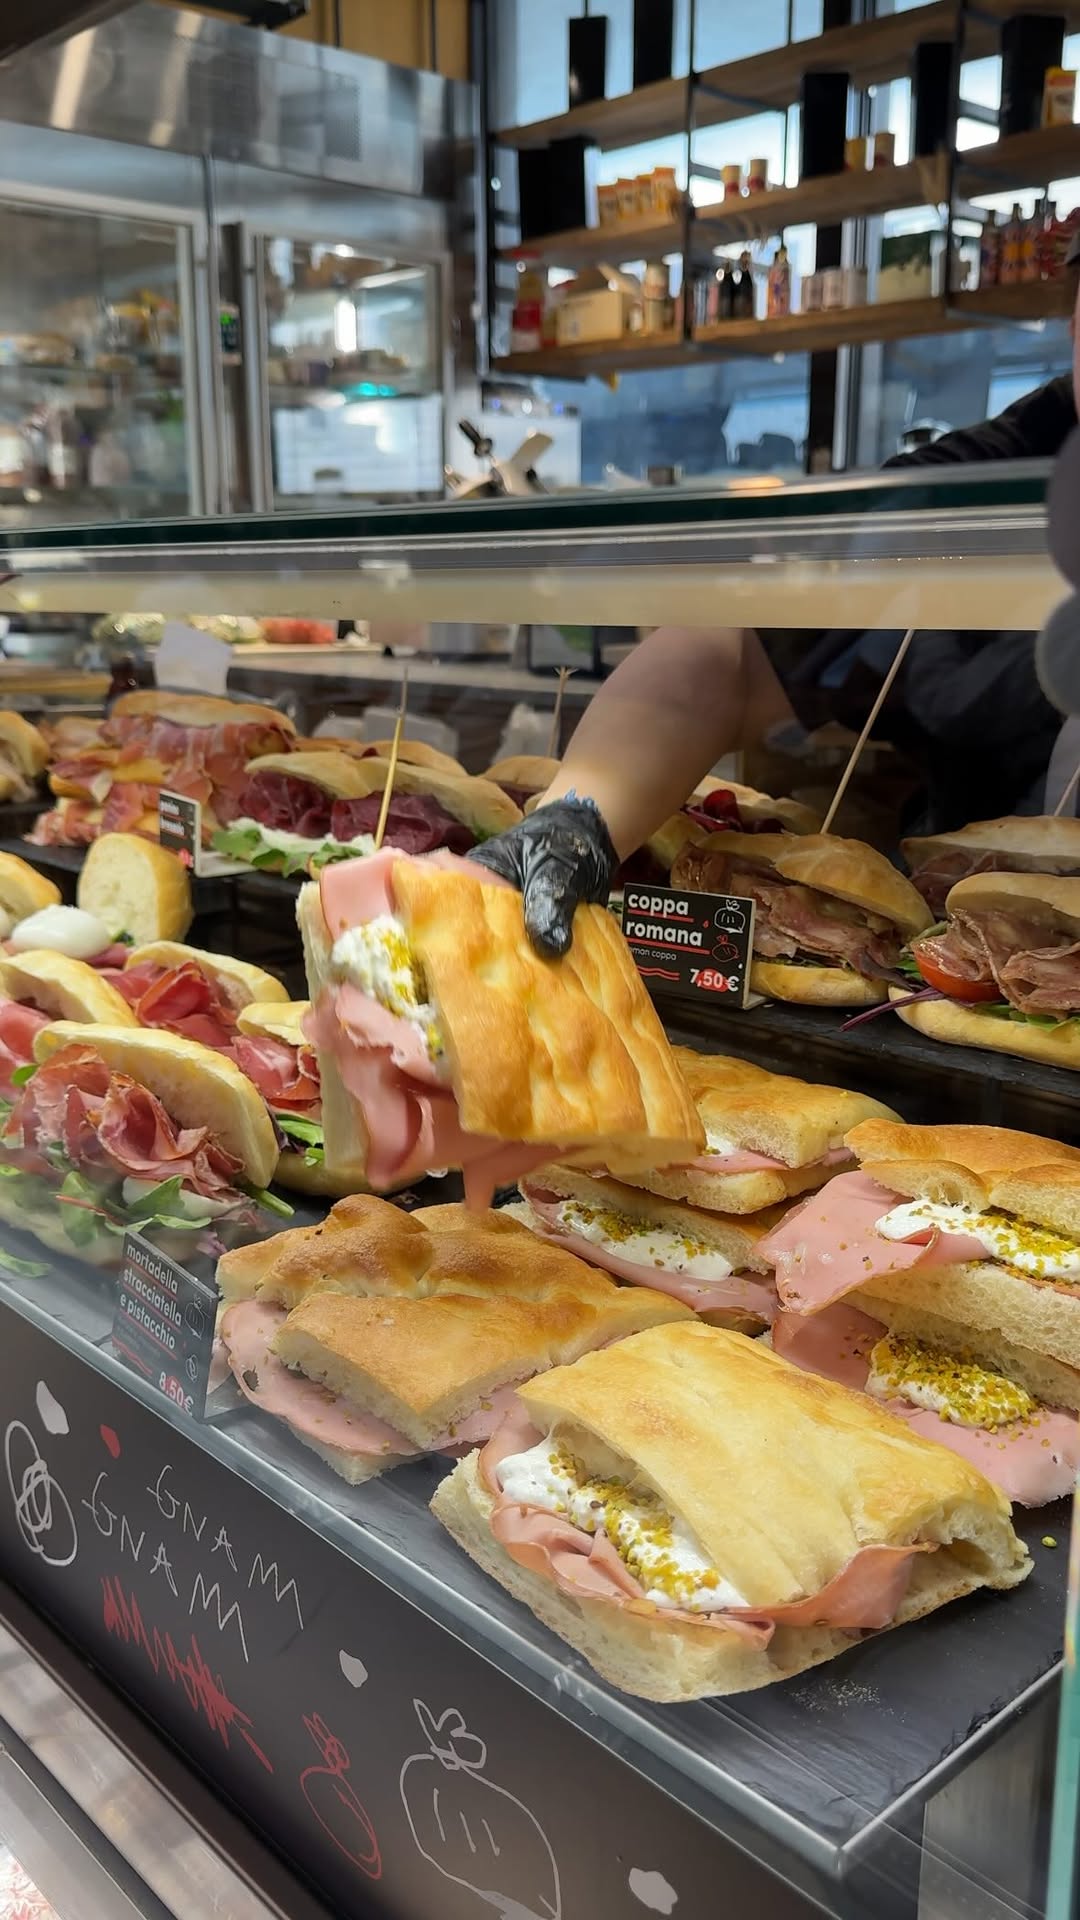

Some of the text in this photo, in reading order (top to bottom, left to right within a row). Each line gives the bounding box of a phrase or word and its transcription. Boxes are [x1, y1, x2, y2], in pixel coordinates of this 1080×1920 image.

[628, 894, 689, 917] coppa
[626, 921, 702, 946] romana
[651, 950, 677, 961] coppa
[689, 968, 740, 992] 7,50€
[126, 1243, 178, 1295] mortadella
[123, 1268, 182, 1327] stracciatella
[119, 1294, 126, 1307] e
[127, 1297, 175, 1350] pistacchio
